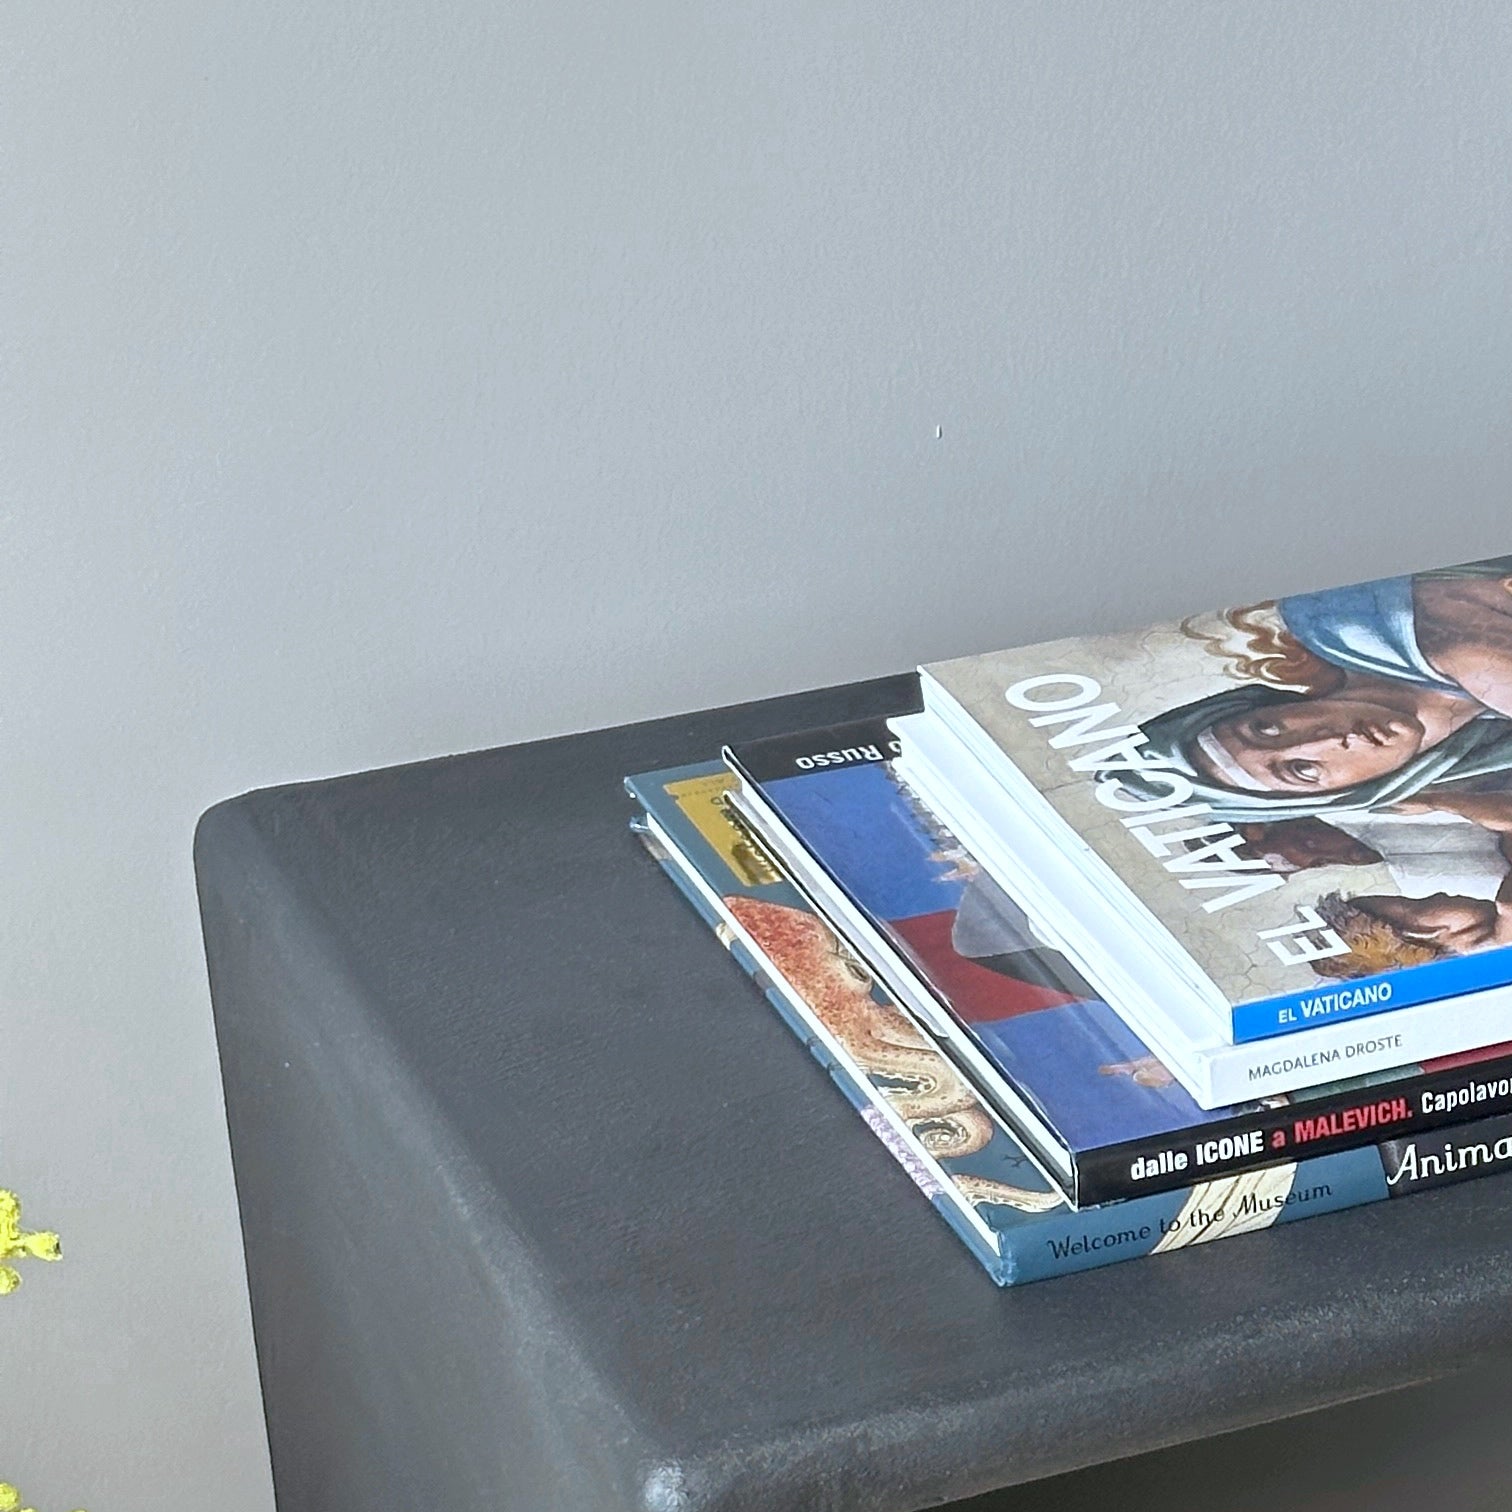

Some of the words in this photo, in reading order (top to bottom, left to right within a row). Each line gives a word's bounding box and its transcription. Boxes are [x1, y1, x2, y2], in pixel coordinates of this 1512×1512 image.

[795, 744, 885, 770] Russo
[1004, 672, 1287, 914] VATICANO
[1257, 903, 1353, 967] EL
[1278, 1008, 1298, 1024] EL
[1300, 981, 1393, 1019] VATICANO
[1247, 1049, 1342, 1081] MAGDALENA
[1344, 1034, 1403, 1059] DROSTE
[1130, 1148, 1188, 1182] dalle
[1195, 1130, 1265, 1167] ICONE
[1271, 1129, 1287, 1149] a
[1293, 1097, 1413, 1145] MALEVICH.
[1047, 1224, 1151, 1260] Welcome
[1159, 1217, 1181, 1233] to
[1189, 1205, 1225, 1228] the
[1232, 1183, 1334, 1220] Museum
